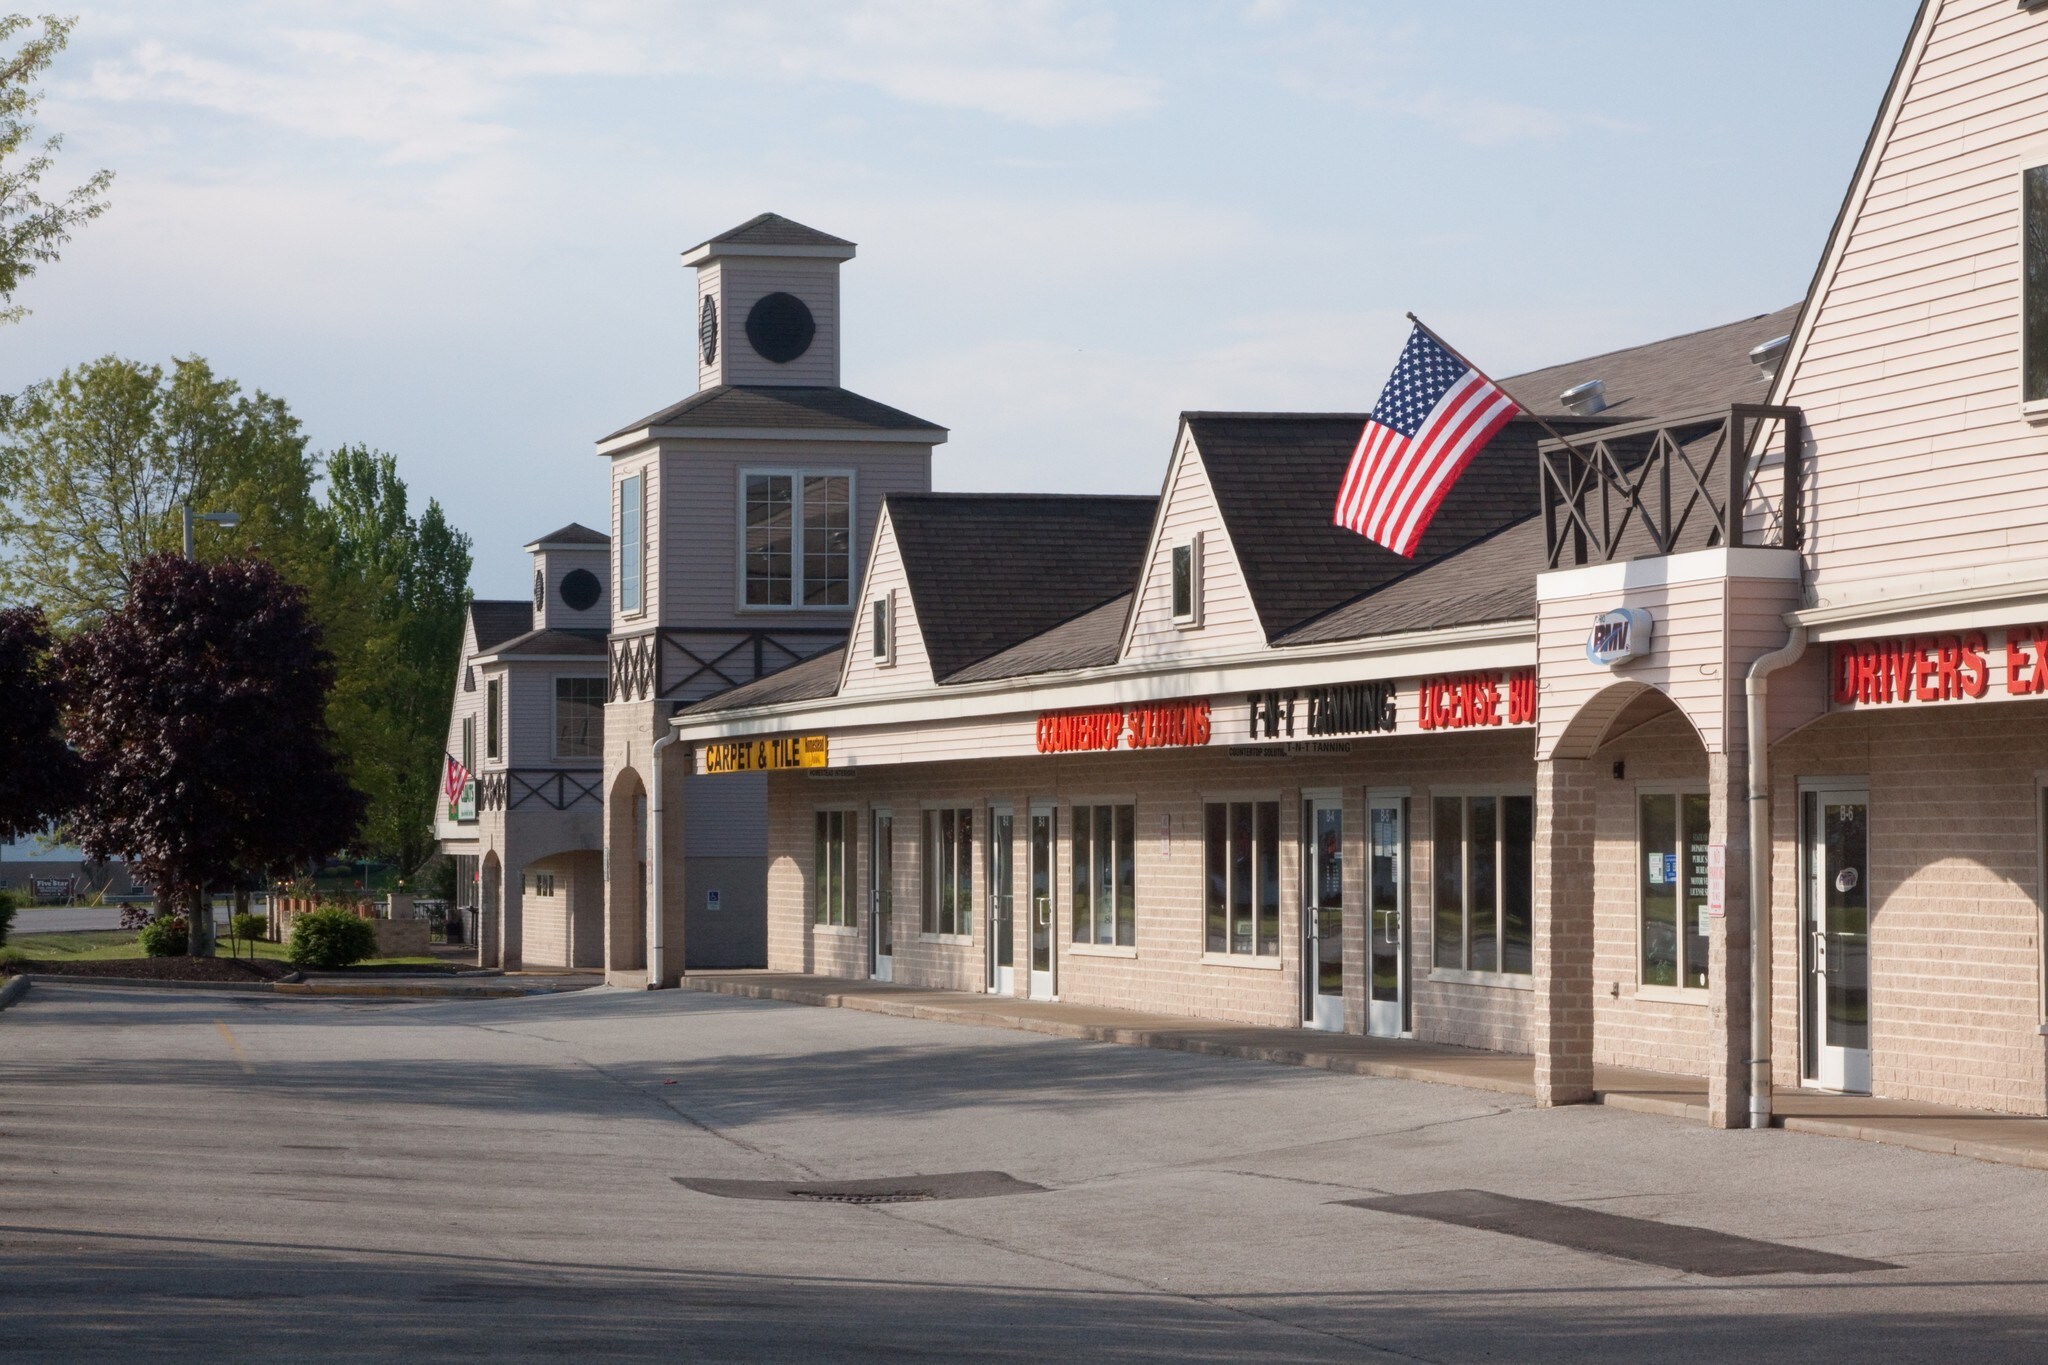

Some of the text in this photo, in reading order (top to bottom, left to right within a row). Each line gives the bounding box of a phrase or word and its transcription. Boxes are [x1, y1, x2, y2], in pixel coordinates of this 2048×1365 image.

[1593, 621, 1629, 653] BMV
[1834, 630, 1990, 704] DRIVERS
[1247, 681, 1397, 739] T-N-T TANNING
[1419, 673, 1502, 730] LICENSE
[1036, 699, 1211, 754] COUNTERTOP SOLUTIONS
[1286, 742, 1351, 752] T-N-T TANNING
[706, 741, 753, 772] CARPET
[758, 741, 767, 769] &
[772, 738, 800, 768] TILE
[1840, 805, 1854, 821] B-6
